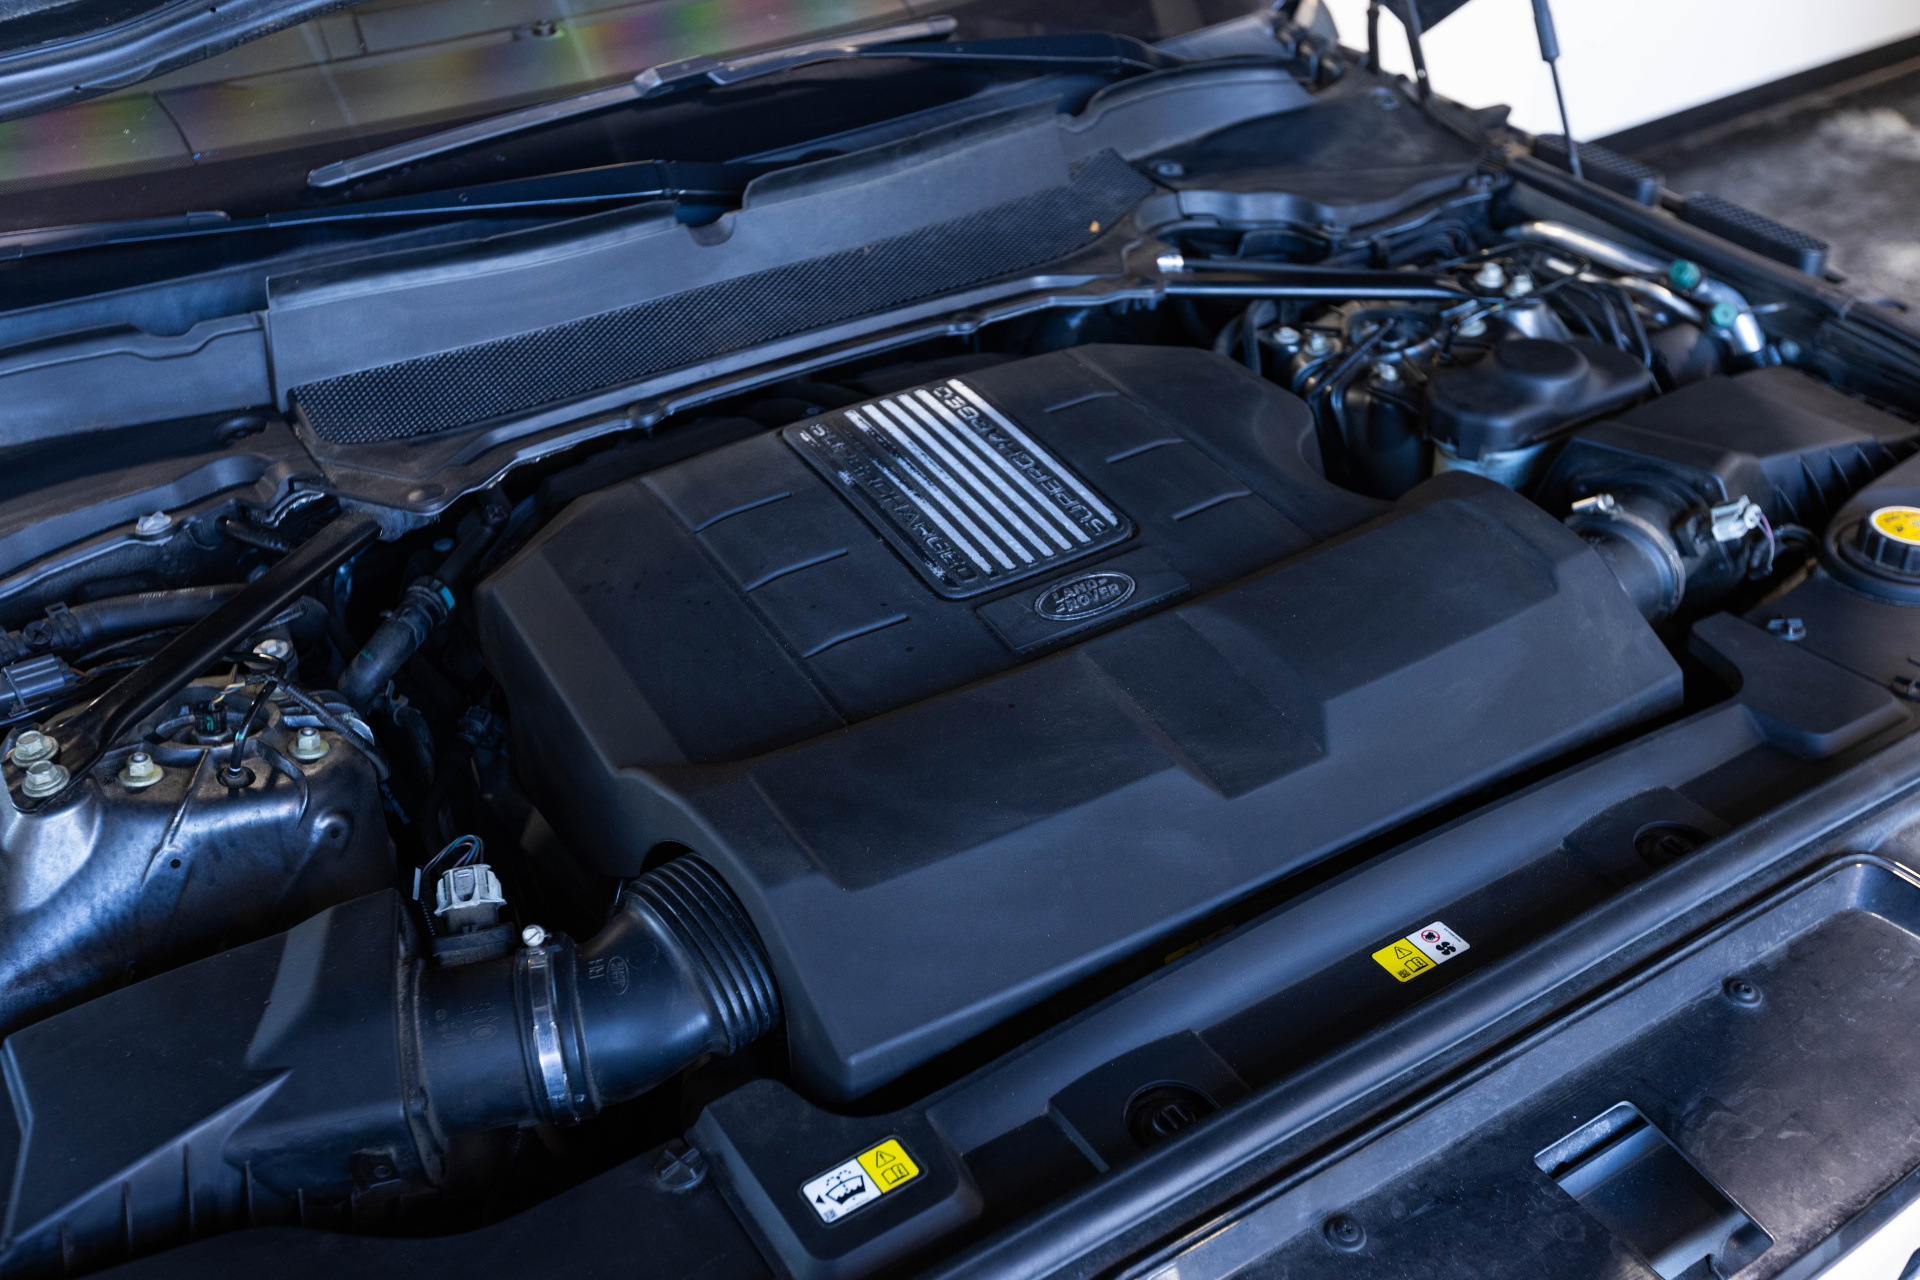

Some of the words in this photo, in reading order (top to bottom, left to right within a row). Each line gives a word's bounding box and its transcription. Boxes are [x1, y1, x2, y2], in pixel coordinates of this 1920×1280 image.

[933, 386, 1108, 535] SUPERCHARGED
[1052, 579, 1098, 604] LAND
[1065, 583, 1121, 612] ROVER
